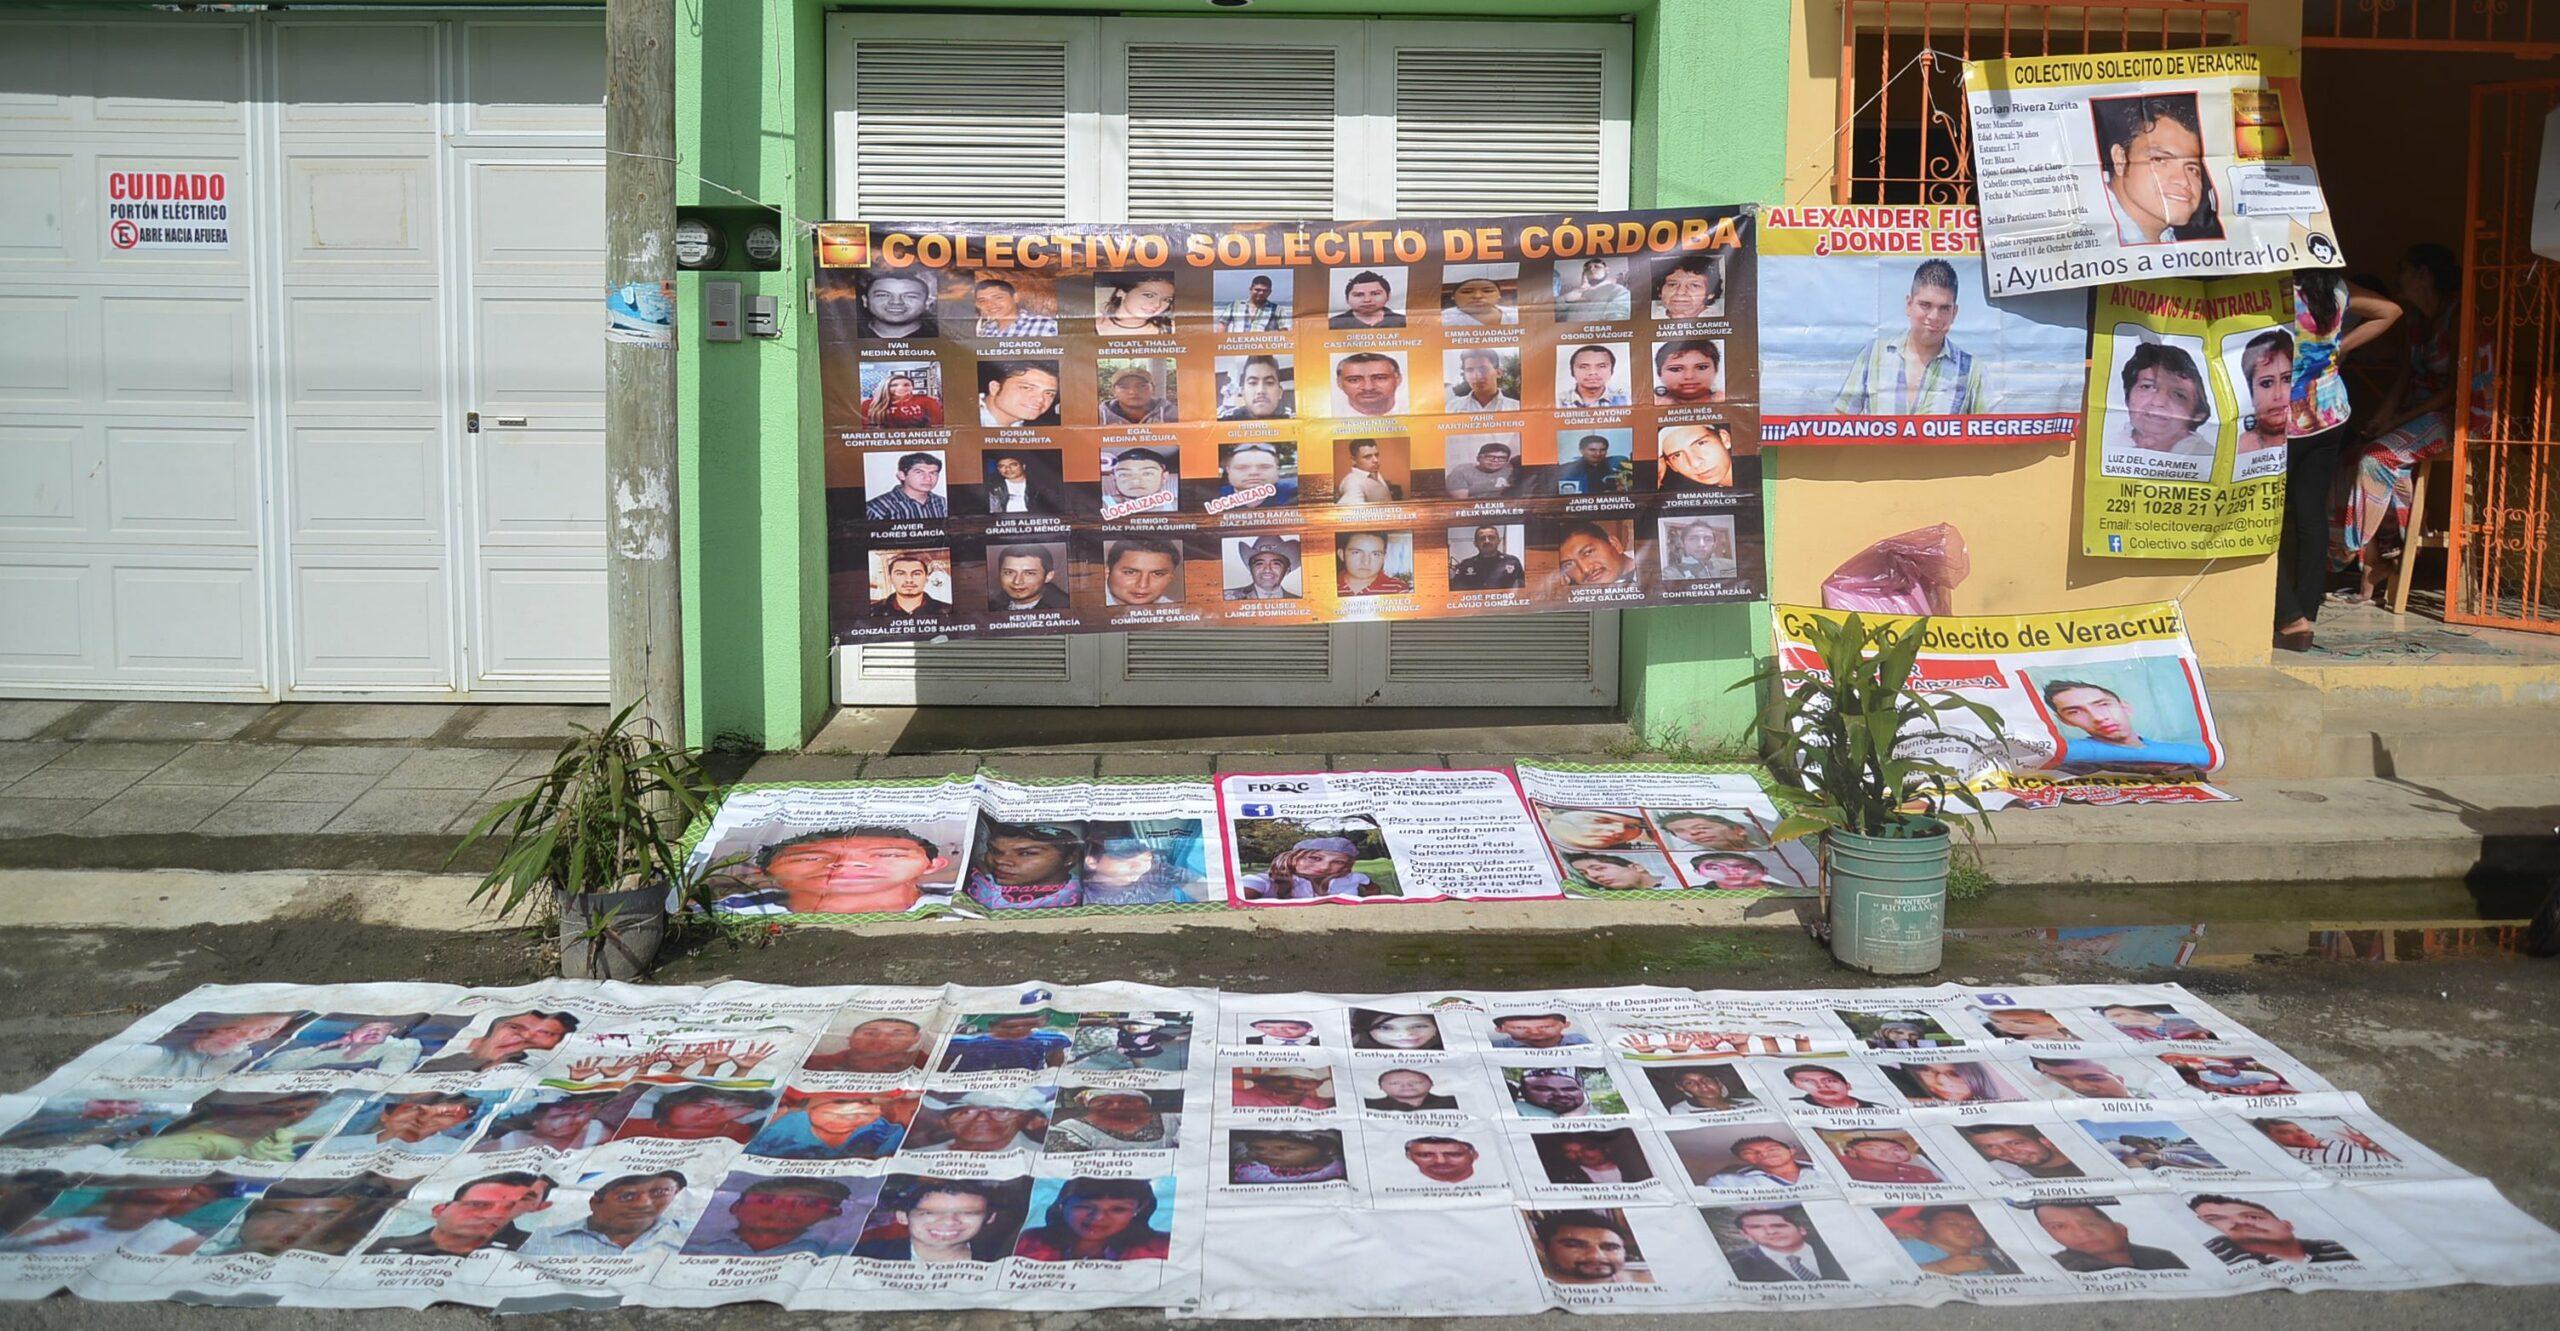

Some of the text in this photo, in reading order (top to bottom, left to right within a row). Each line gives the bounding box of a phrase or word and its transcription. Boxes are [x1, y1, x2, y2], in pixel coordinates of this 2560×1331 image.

[2015, 53, 2257, 84] COLECTIVO SOLECITO DE VERACRUZ
[1974, 102, 2078, 115] Dorian Rivera Zurita
[110, 173, 224, 201] CUIDADO
[111, 201, 226, 220] PORTÓN ELÉCTRICO
[1768, 208, 1979, 228] ALEXANDER FIG
[140, 228, 228, 243] ABRE HACIA AFUERA
[882, 234, 1169, 269] COLECTIVO
[1185, 231, 1426, 267] SOLECITO
[1445, 229, 1504, 261] DE
[1520, 218, 1741, 259] CÓRDOBA
[1816, 232, 1984, 255] ¿DONDE EST
[1994, 242, 2299, 294] ¡Ayudanos a encontrarlo!
[1131, 346, 1187, 354] HERNÁNDEZ
[1903, 422, 1917, 436] A
[1923, 421, 1961, 438] QUE
[845, 439, 902, 447] CONTRERAS
[2108, 455, 2197, 470] LUZ DEL CARMEN
[2251, 453, 2275, 465] MARÍA
[2105, 465, 2199, 479] SAYAS RODRÍGUEZ
[2241, 464, 2278, 477] SÁNCHEZ
[1205, 484, 1276, 513] LOCALIZADO
[2121, 484, 2211, 501] INFORMES
[2215, 490, 2227, 501] A
[2231, 484, 2256, 500] LOS
[1101, 491, 1174, 520] LOCALIZADO
[1566, 504, 1600, 512] FLORES
[2107, 499, 2254, 516] 2291 1028 21 Y 2291
[2100, 518, 2131, 530] Email:
[2130, 536, 2254, 550] Colectivo soecito de
[1568, 594, 1595, 603] LÓPEZ
[851, 626, 901, 635] GONZÁLEZ
[1919, 627, 2012, 650] olecito
[2017, 623, 2051, 648] de
[2055, 614, 2178, 644] Veracruz
[1924, 746, 1969, 754] Cabeza
[1462, 873, 1542, 881] Septiembre
[2102, 1103, 2153, 1113] 10/01/16
[2246, 1097, 2297, 1109] 12/05/15
[1959, 1106, 1987, 1116] 2016
[1073, 1160, 1133, 1169] Delgado
[1535, 1180, 1661, 1193] Luis Alberto Granillo
[2031, 1187, 2089, 1196] 28/09/11
[1885, 1192, 1943, 1201] 04/08/14
[717, 1265, 780, 1276] Moreno
[853, 1258, 990, 1272] Argenis Yosimar
[1013, 1258, 1123, 1271] Karina Reyes
[709, 1275, 777, 1287] 02/01/09
[1010, 1271, 1065, 1279] Nieves
[376, 1277, 444, 1287] 16/11/09
[879, 1281, 948, 1290] 16/03/14
[1008, 1281, 1076, 1290] 14/06/11
[1727, 1280, 1805, 1291] Juan Carlos
[2082, 1282, 2146, 1293] 25/02/13
[1760, 1292, 1826, 1302] 28/10/13
